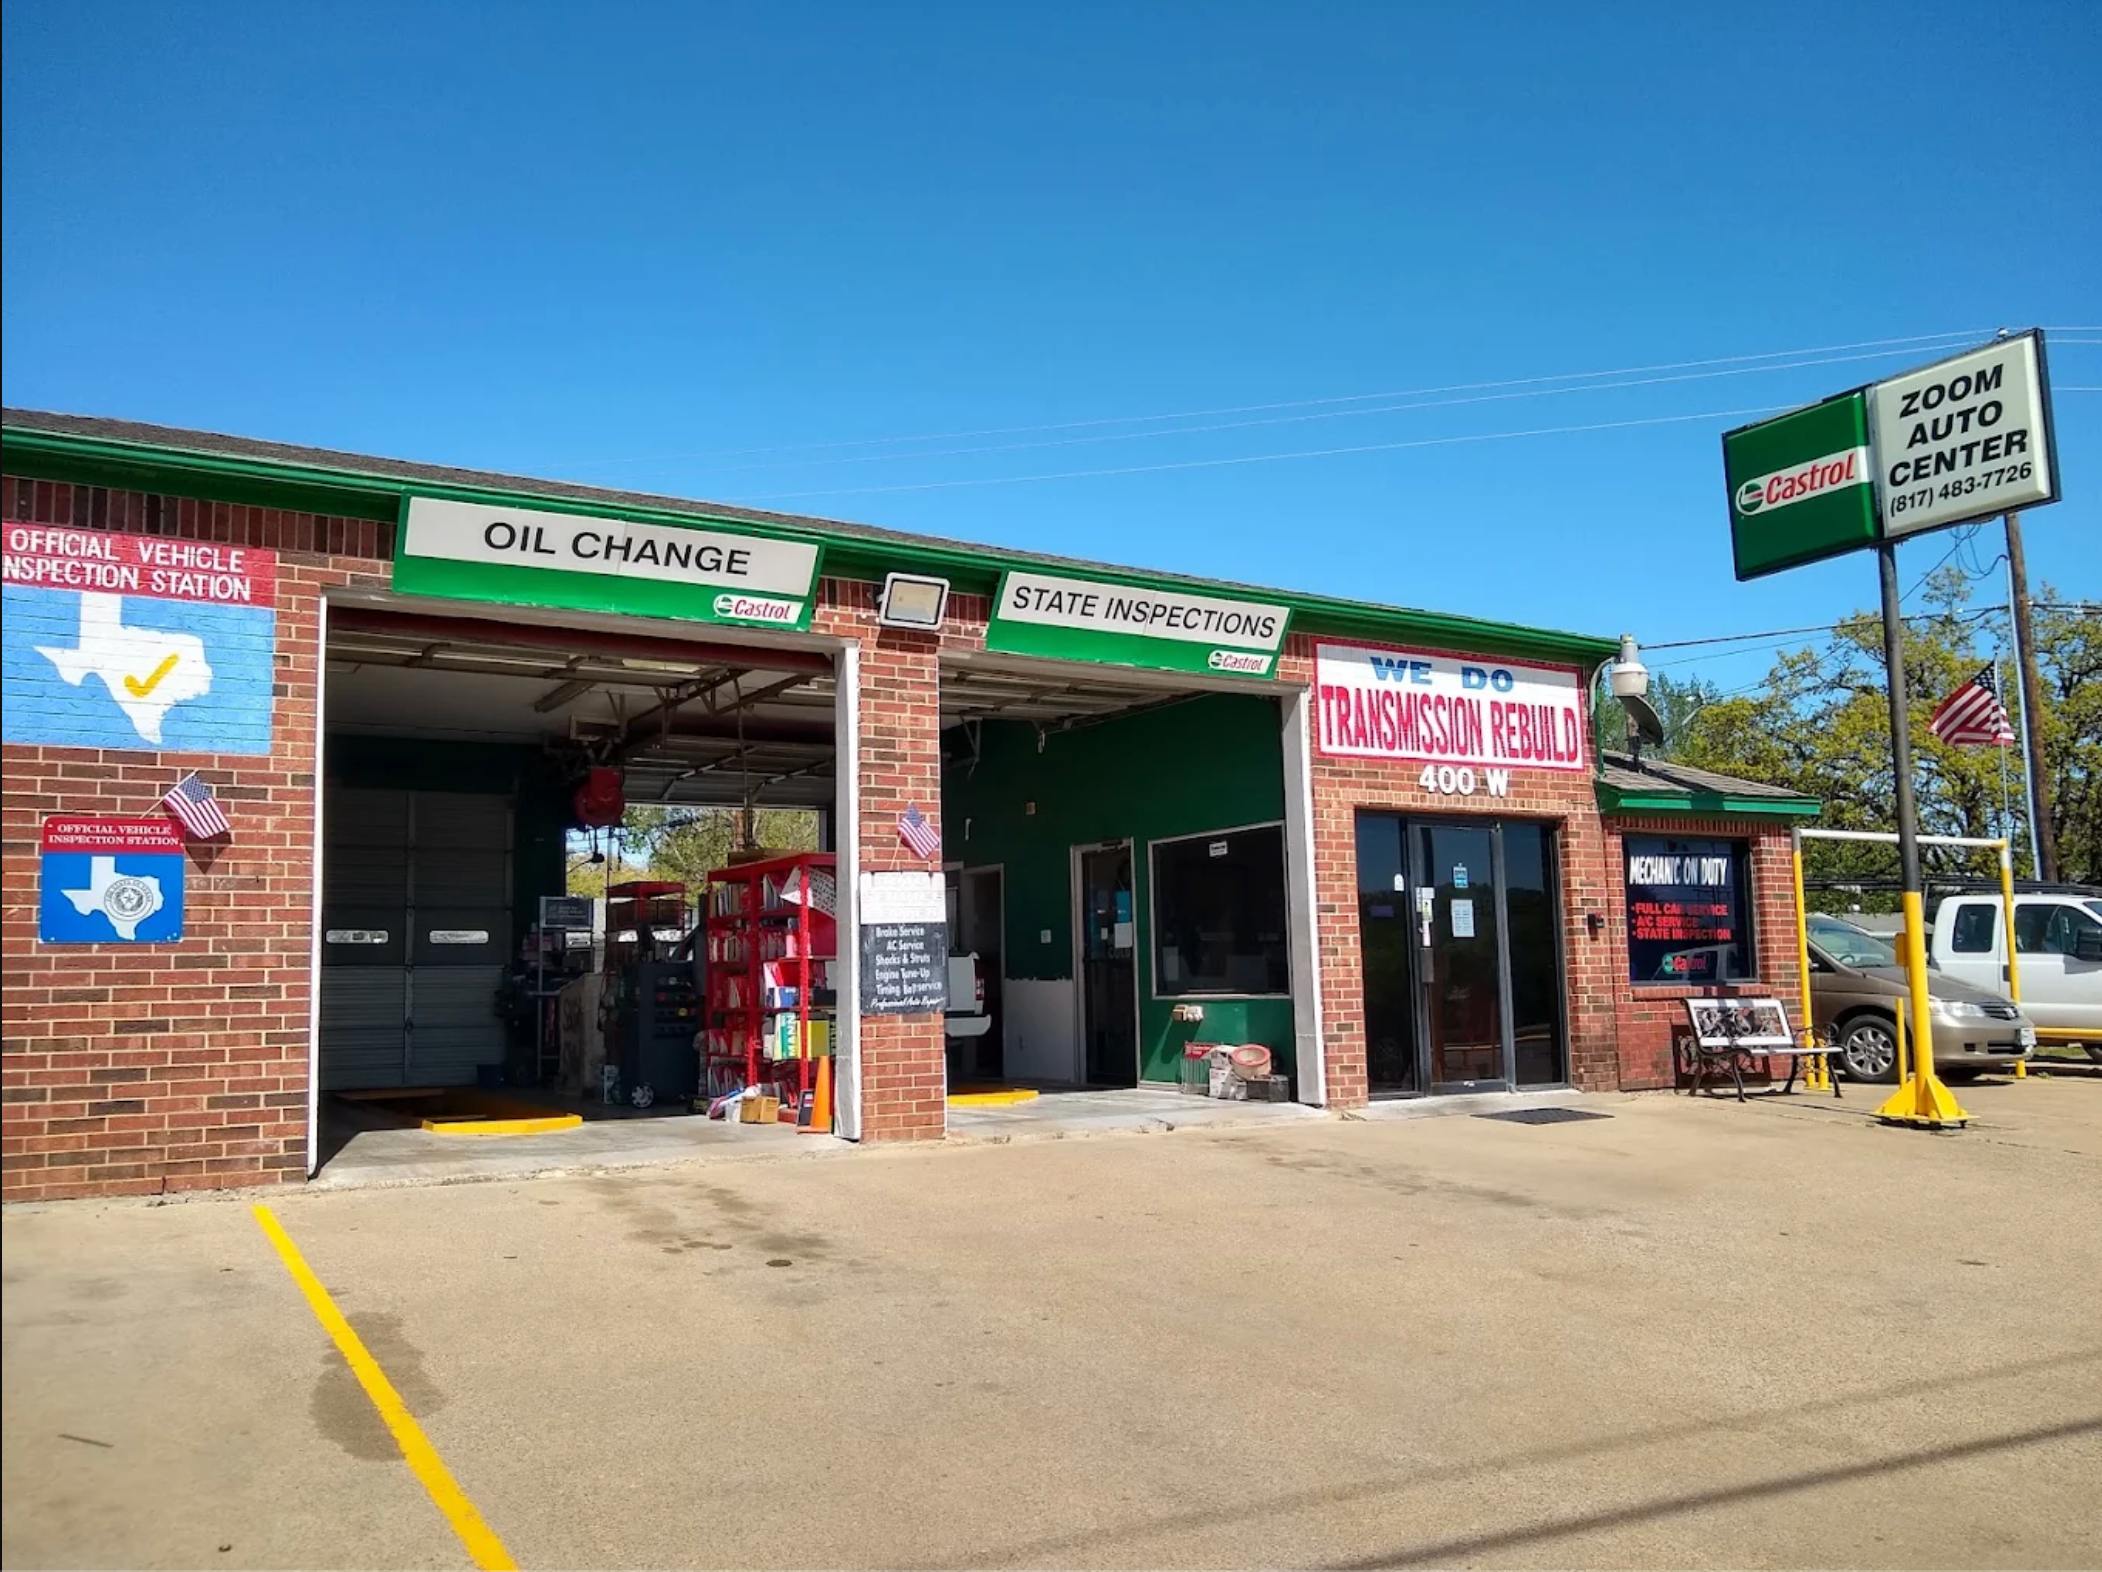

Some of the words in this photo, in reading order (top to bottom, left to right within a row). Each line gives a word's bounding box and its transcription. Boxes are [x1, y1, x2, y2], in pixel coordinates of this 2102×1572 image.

[1899, 364, 2004, 419] ZOOM
[1906, 400, 2003, 449] AUTO
[1889, 428, 2028, 487] CENTER
[1766, 453, 1857, 505] Castrol
[1890, 487, 1935, 517] (817)
[1939, 461, 2032, 501] 483-7726
[9, 528, 120, 561] OFFICIAL
[137, 539, 246, 574] VEHICLE
[483, 522, 556, 555] OIL
[571, 532, 752, 577] CHANGE
[3, 554, 139, 591] NSPECTION
[151, 570, 252, 601] STATION
[733, 599, 792, 621] Castrol
[1013, 585, 1099, 618] STATE
[1104, 597, 1276, 639] INSPECTIONS
[1222, 653, 1265, 671] Castrol
[1370, 657, 1432, 684] WE
[1461, 666, 1515, 693] DO
[1320, 684, 1485, 757] TRANSMISSION
[1490, 700, 1579, 763] REBUILD
[1418, 765, 1476, 796] 400
[1486, 767, 1510, 797] W
[48, 834, 124, 845] INSPECTION
[127, 836, 178, 846] STATION
[57, 823, 117, 834] OFFICIAL
[118, 824, 171, 835] VEHICLE
[1629, 856, 1681, 885] MECHANIC
[1683, 856, 1698, 885] ON
[1701, 857, 1728, 886] DUTY
[1636, 903, 1661, 914] FULL
[1656, 916, 1699, 928] SERVICE
[899, 925, 925, 937] Service
[899, 939, 925, 951] Service
[1637, 928, 1670, 939] STATE
[1672, 928, 1731, 939] INSPECTION
